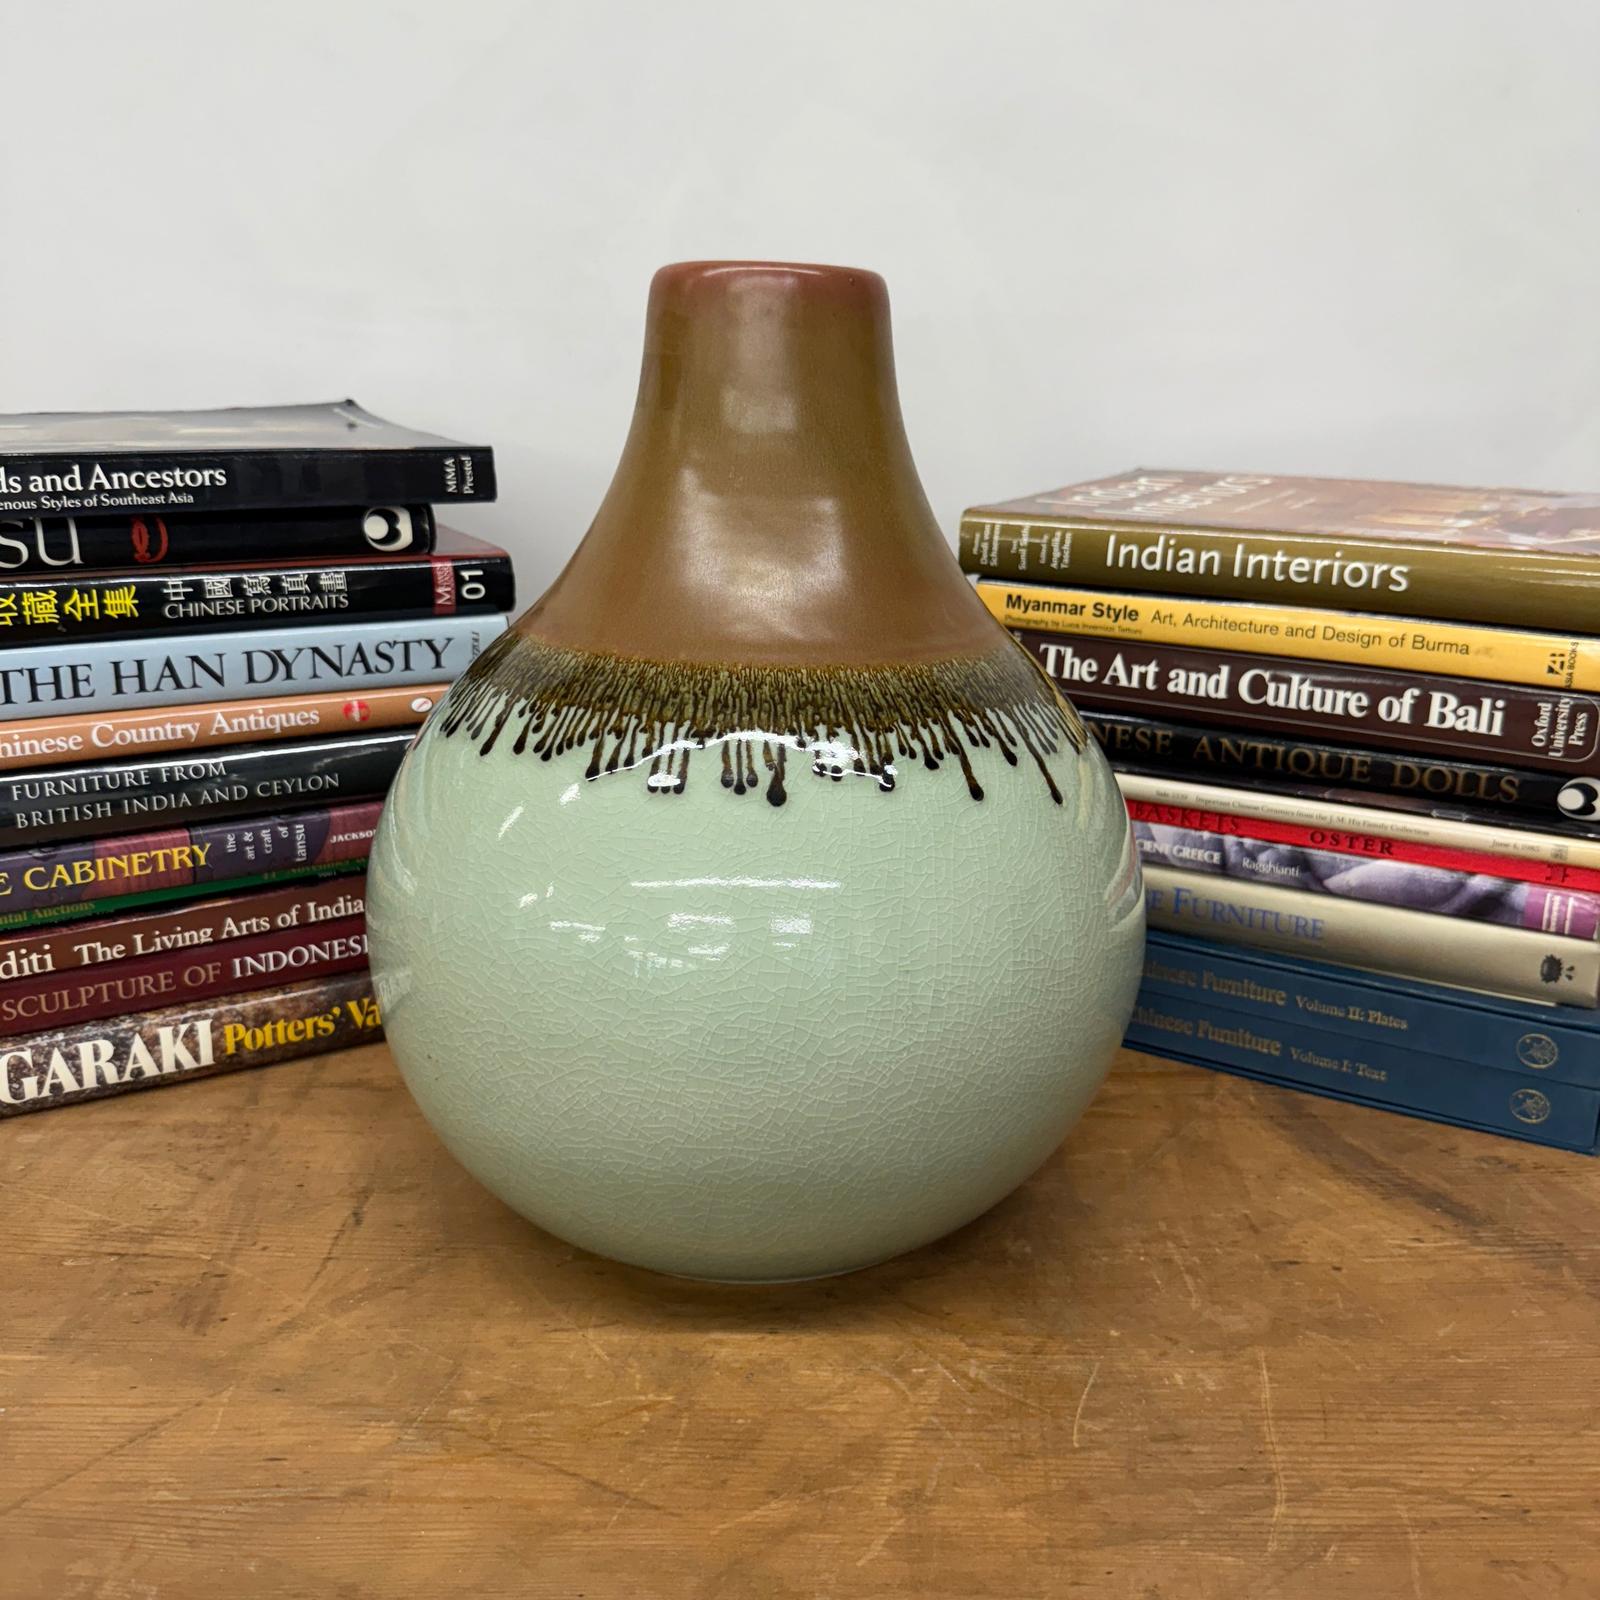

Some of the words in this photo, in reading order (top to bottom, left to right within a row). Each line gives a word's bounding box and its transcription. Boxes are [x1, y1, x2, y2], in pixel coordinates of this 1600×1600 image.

[29, 464, 83, 492] and
[88, 463, 227, 491] Ancestors
[444, 458, 458, 493] MMA
[461, 456, 474, 494] Prestel
[41, 495, 81, 511] Styles
[83, 494, 98, 507] of
[100, 492, 166, 507] Southeast
[168, 492, 194, 504] Asia
[1106, 533, 1221, 576] Indian
[1233, 542, 1409, 592] Interiors
[460, 570, 486, 599] 01
[164, 600, 245, 619] CHINESE
[251, 593, 349, 614] PORTRAITS
[1006, 594, 1086, 615] Myanmar
[1092, 601, 1139, 623] Style
[1150, 609, 1177, 627] Art,
[1182, 612, 1279, 635] Architecture
[1285, 625, 1316, 639] and
[1322, 625, 1382, 648] Design
[1388, 633, 1406, 648] of
[1412, 634, 1470, 655] Burma
[0, 663, 96, 705] THE
[110, 653, 226, 695] HAN
[241, 637, 454, 684] DYNASTY
[1039, 642, 1098, 683] The
[1102, 652, 1160, 690] Art
[1166, 664, 1231, 699] and
[1238, 668, 1369, 718] Culture
[1377, 687, 1421, 724] of
[1424, 690, 1506, 736] Bali
[91, 722, 200, 748] Country
[209, 708, 320, 735] Antiques
[1531, 701, 1553, 747] Oxford
[1549, 696, 1574, 757] University
[1568, 712, 1589, 746] Press
[11, 769, 152, 801] FURNITURE
[161, 761, 227, 783] FROM
[1193, 735, 1372, 782] ANTIQUE
[1391, 760, 1520, 801] DOLLS
[16, 801, 112, 829] BRITISH
[123, 792, 193, 815] INDIA
[200, 784, 249, 806] AND
[256, 772, 340, 798] CEYLON
[226, 832, 237, 853] the
[243, 831, 254, 842] &
[261, 828, 273, 854] craft
[277, 826, 289, 838] of
[1309, 831, 1394, 855] OSTER
[24, 843, 211, 890] CABINETRY
[244, 845, 256, 861] art
[1172, 844, 1222, 865] GREECE
[1242, 856, 1300, 878] Ragghianti
[32, 902, 96, 918] Auctions
[1173, 886, 1325, 940] FURNITURE
[73, 941, 126, 966] The
[132, 926, 213, 955] Living
[220, 917, 271, 940] Arts
[276, 904, 300, 928] of
[306, 895, 365, 923] India
[3, 971, 177, 1021] SCULPTURE
[184, 962, 222, 987] OF
[1202, 968, 1287, 1007] Furniture
[1295, 995, 1345, 1018] Volume
[1368, 1008, 1408, 1031] Plates
[0, 1019, 216, 1104] GARAKI
[1197, 1018, 1282, 1057] Furniture
[1290, 1046, 1339, 1070] Volume
[1356, 1062, 1388, 1082] Text
